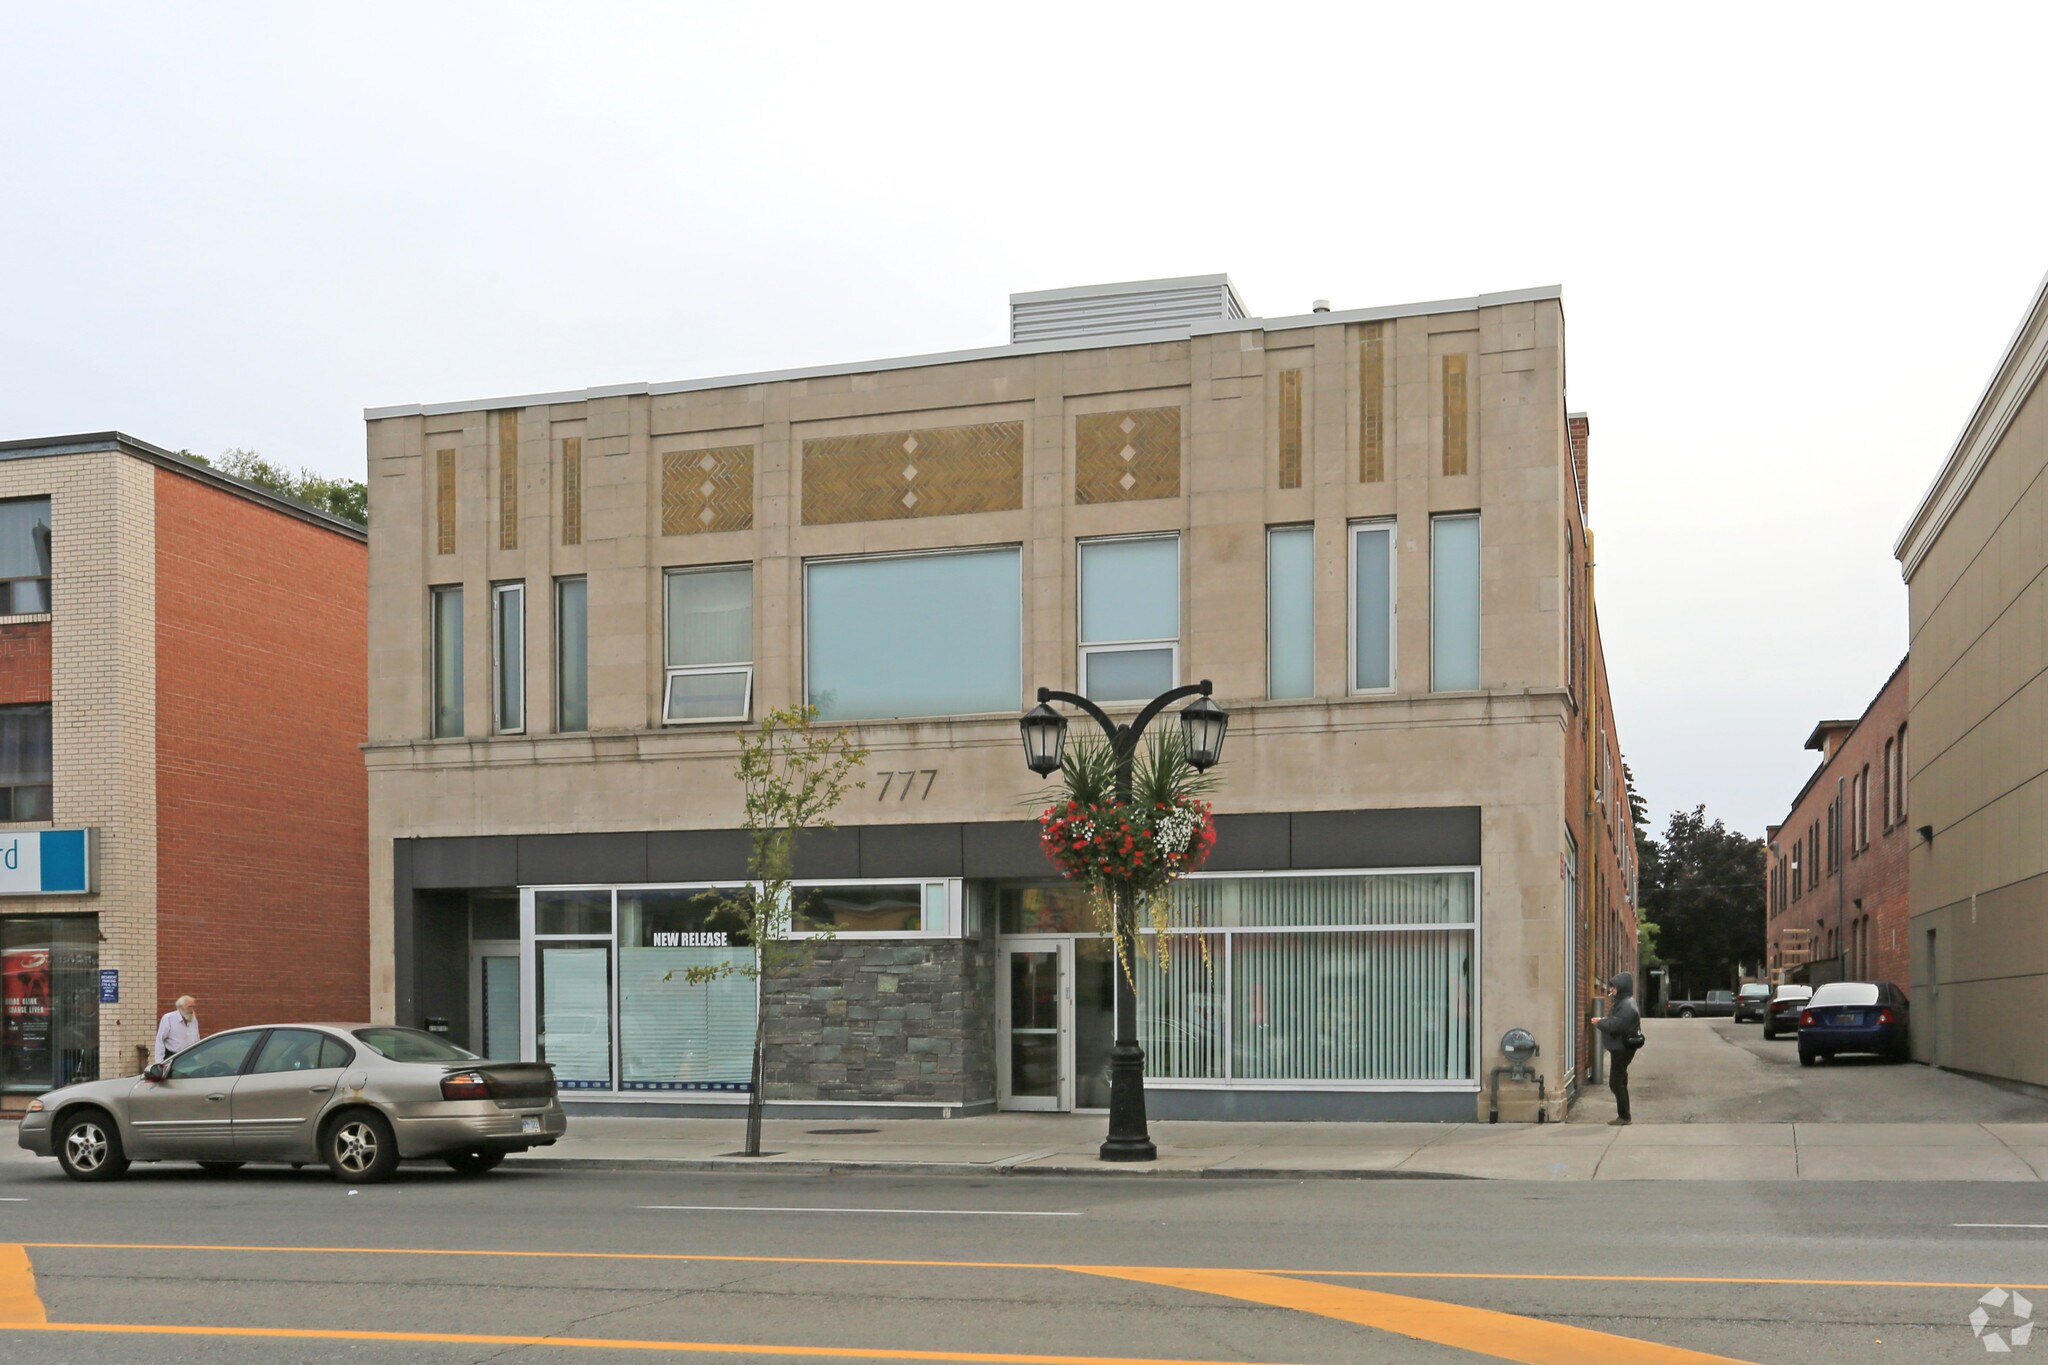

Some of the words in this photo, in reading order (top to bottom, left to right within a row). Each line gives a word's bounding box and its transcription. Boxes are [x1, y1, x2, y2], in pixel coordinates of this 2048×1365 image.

[877, 769, 938, 802] 777
[653, 932, 679, 947] NEW
[681, 932, 728, 947] RELEASE
